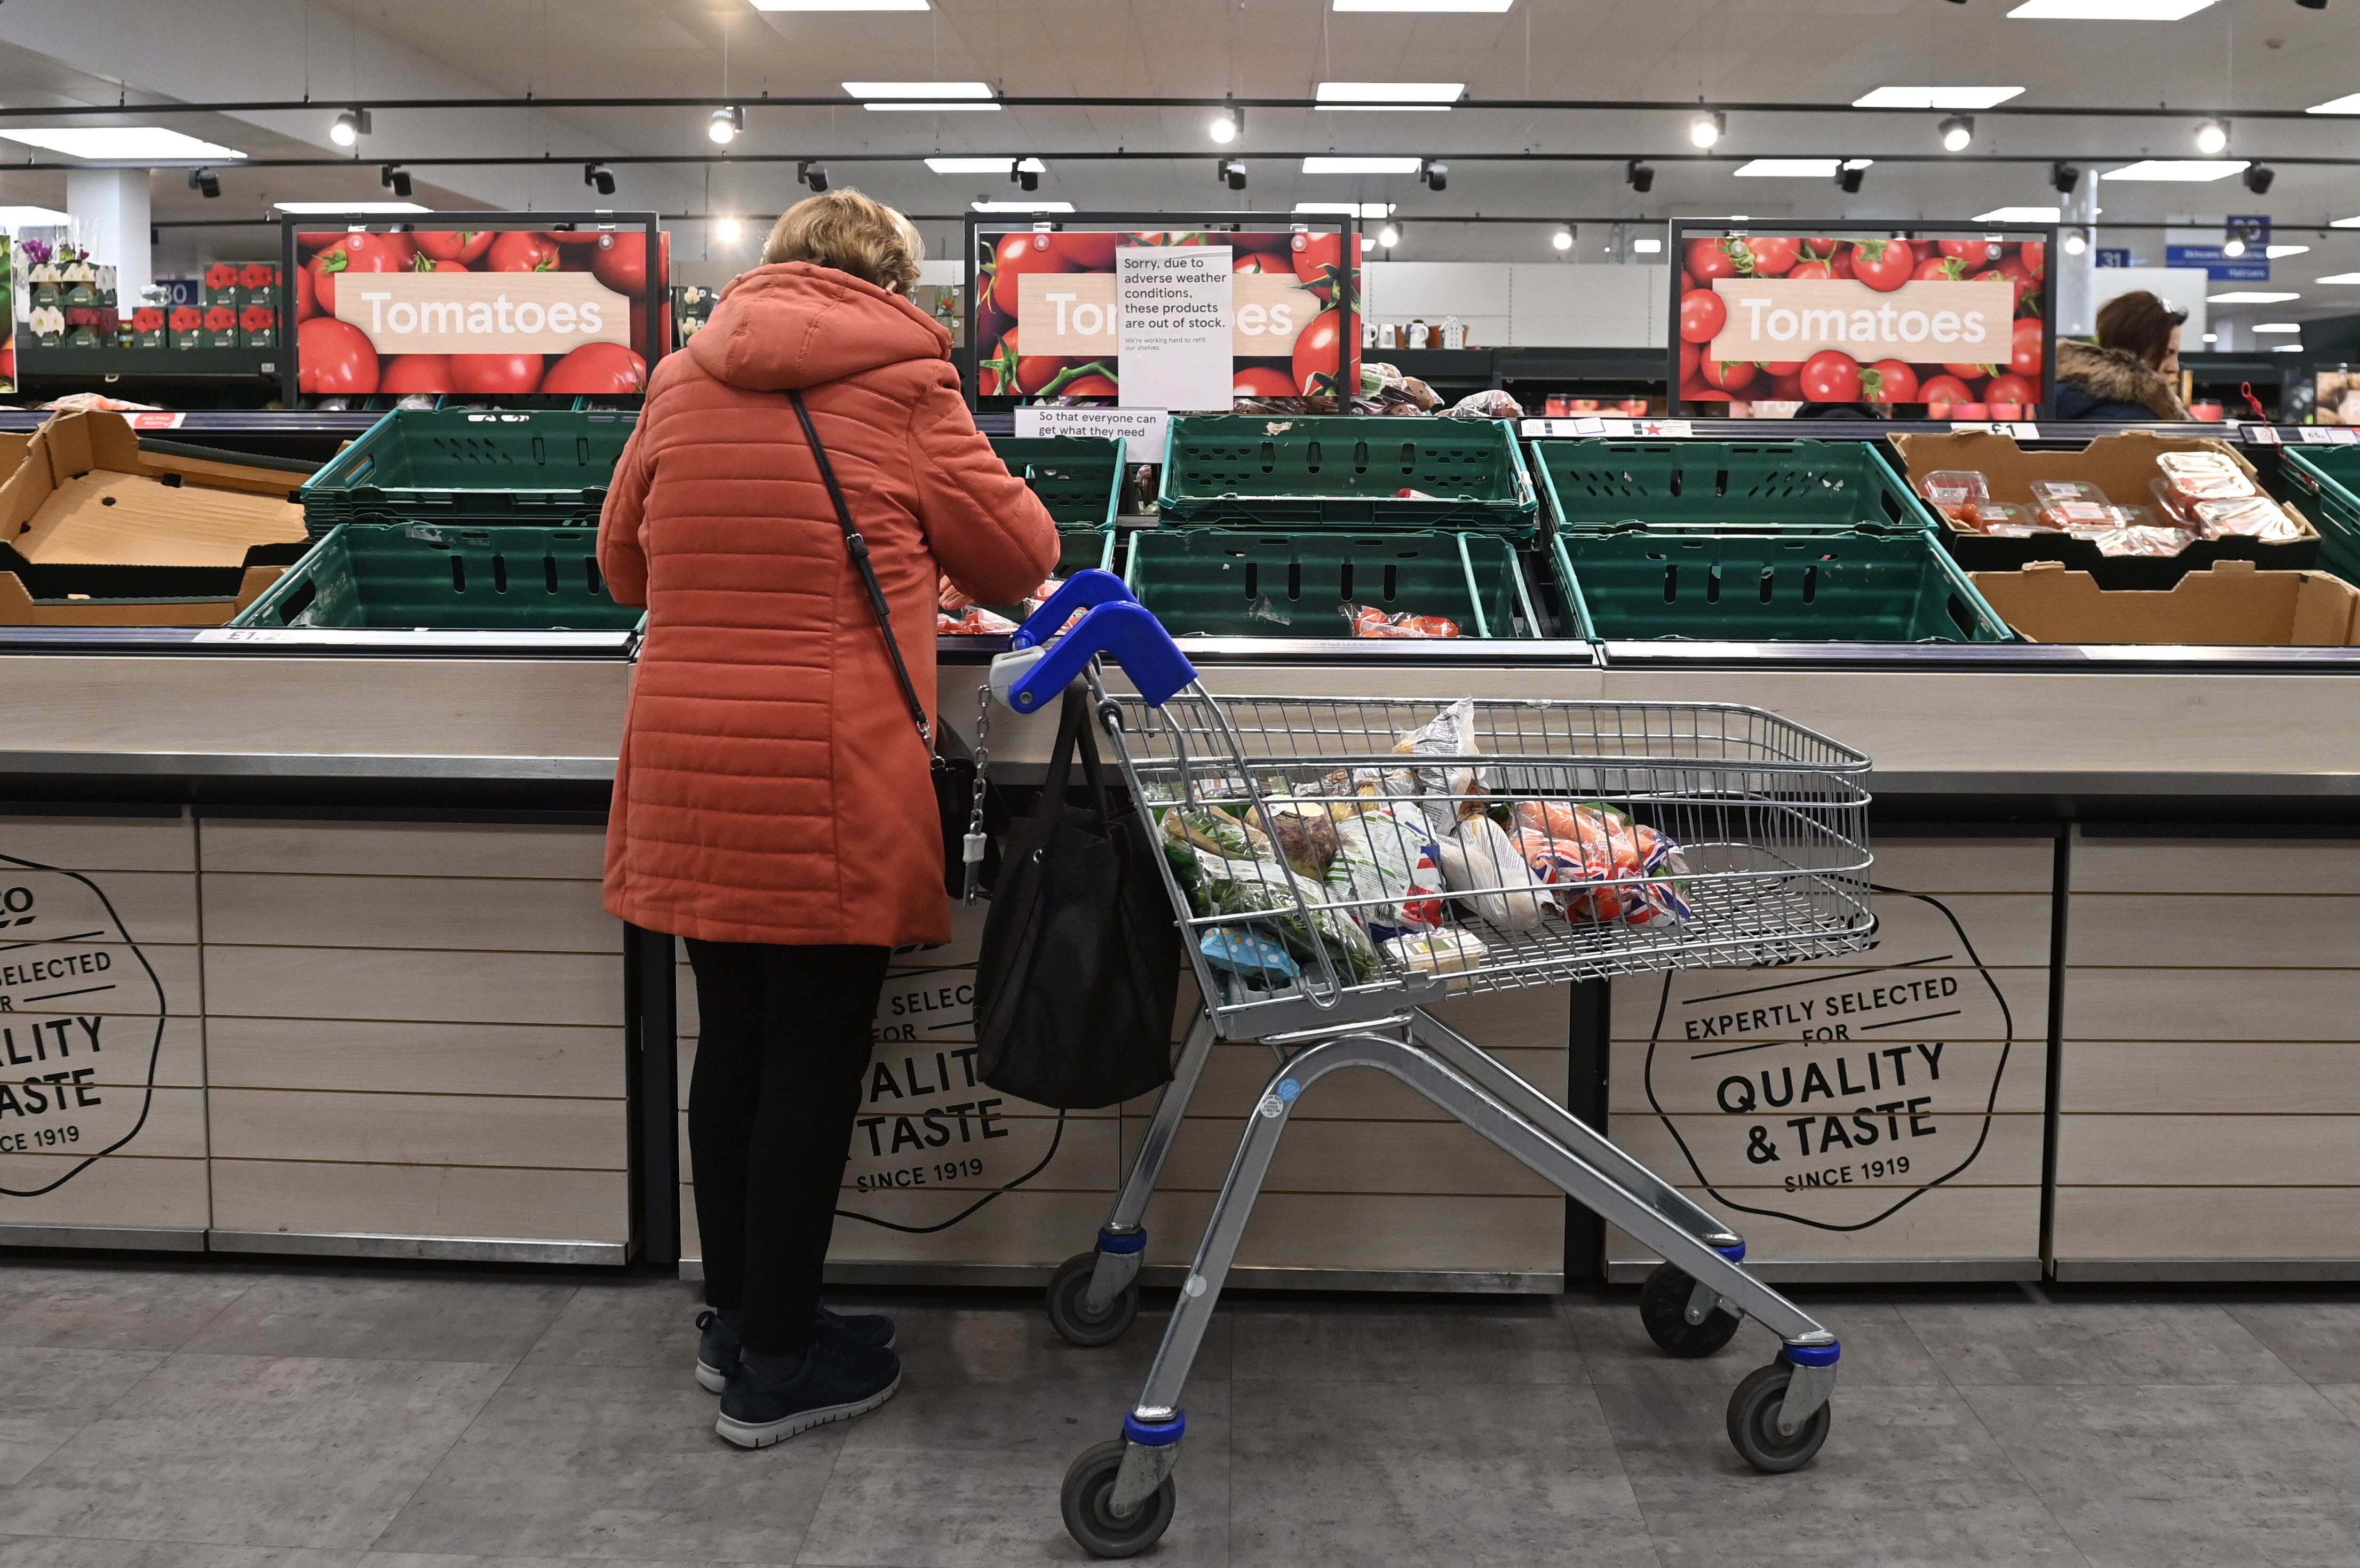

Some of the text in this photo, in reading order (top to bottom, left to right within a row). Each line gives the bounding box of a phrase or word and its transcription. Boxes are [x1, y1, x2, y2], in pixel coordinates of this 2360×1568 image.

[1124, 258, 1204, 270] Sorry, due to
[1125, 273, 1227, 283] adverse weather
[1125, 288, 1193, 299] conditions,
[1125, 303, 1218, 315] these products
[362, 292, 602, 333] Tomatoes
[1125, 317, 1226, 328] are out of stock.
[1741, 299, 1986, 343] Tomatoes
[1039, 411, 1156, 425] So that everyone can
[1039, 426, 1145, 438] get what they need
[1991, 423, 2016, 437] £1
[0, 952, 110, 987] ELECTED
[892, 985, 975, 1015] SELEC
[1684, 976, 1958, 1041] EXPERTLY SELECTED
[0, 1016, 101, 1066] LITY
[1802, 1024, 1850, 1046] FOR
[869, 1047, 978, 1103] ALIT
[1717, 1042, 1944, 1114] QUALITY
[0, 1068, 101, 1119] ASTE
[34, 1126, 79, 1147] 1919
[856, 1098, 1009, 1157] TASTE
[1746, 1096, 1936, 1165] & TASTE
[856, 1158, 983, 1193] SINCE 1919
[1784, 1156, 1910, 1193] SINCE 1919
